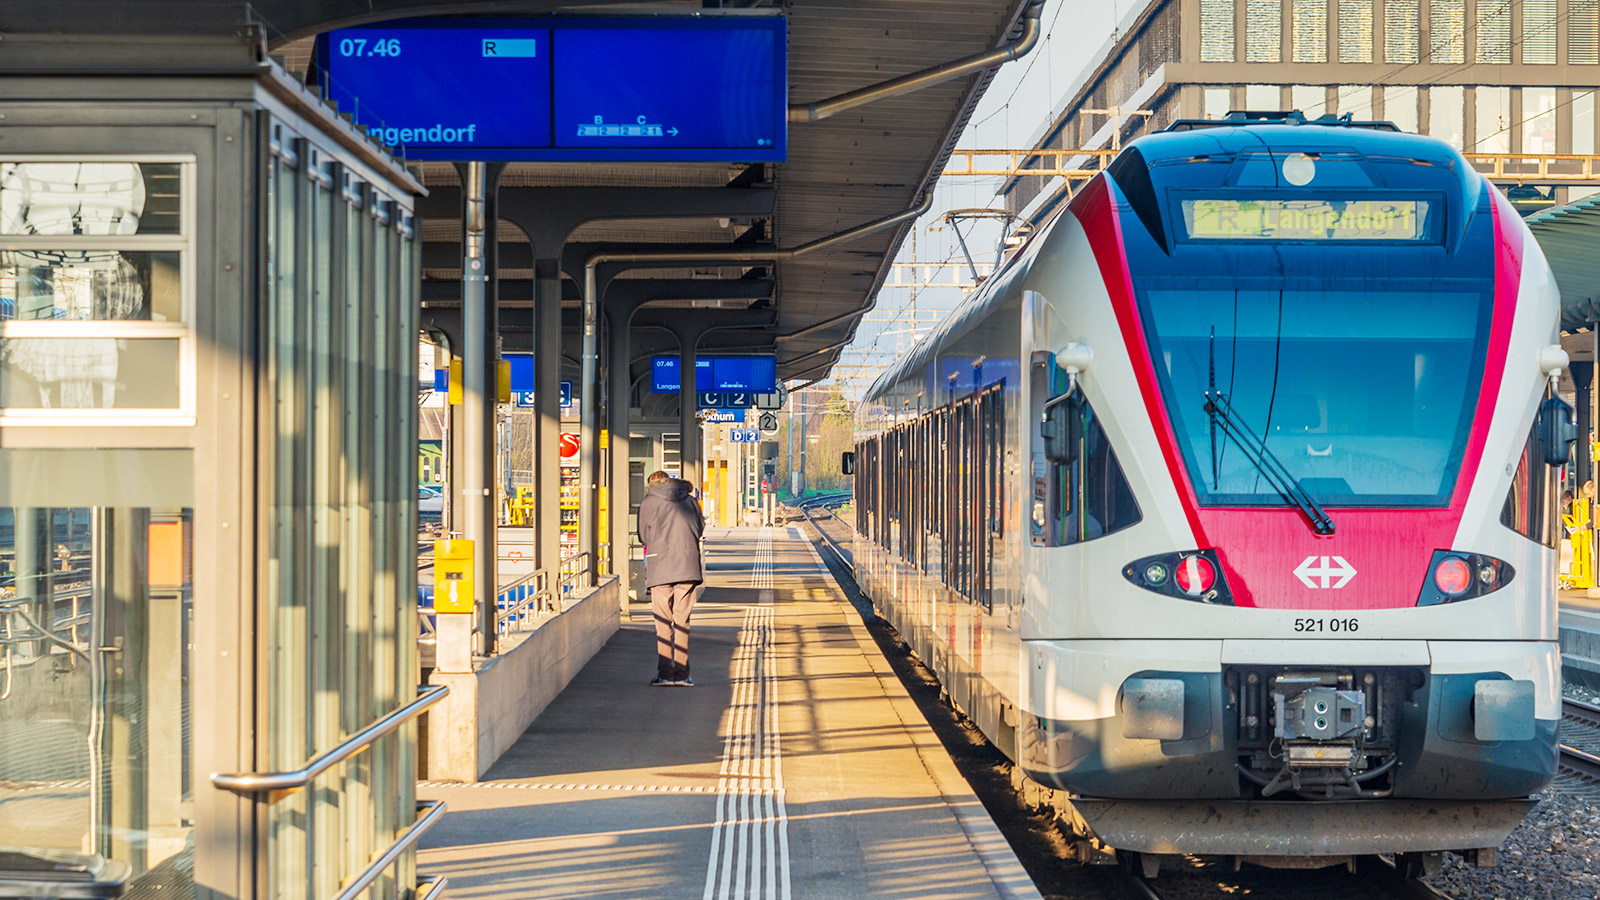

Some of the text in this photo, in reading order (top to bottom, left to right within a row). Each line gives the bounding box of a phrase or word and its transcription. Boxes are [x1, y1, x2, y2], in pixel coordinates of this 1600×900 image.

[339, 38, 497, 57] 07.46 R
[594, 114, 647, 125] B C
[366, 123, 476, 147] ngendorf
[1218, 201, 1412, 235] R Langendorf
[656, 360, 674, 368] 07.46
[705, 393, 745, 405] C 2
[763, 416, 772, 429] 2
[734, 430, 756, 441] D 2
[1294, 618, 1359, 632] 521 016
